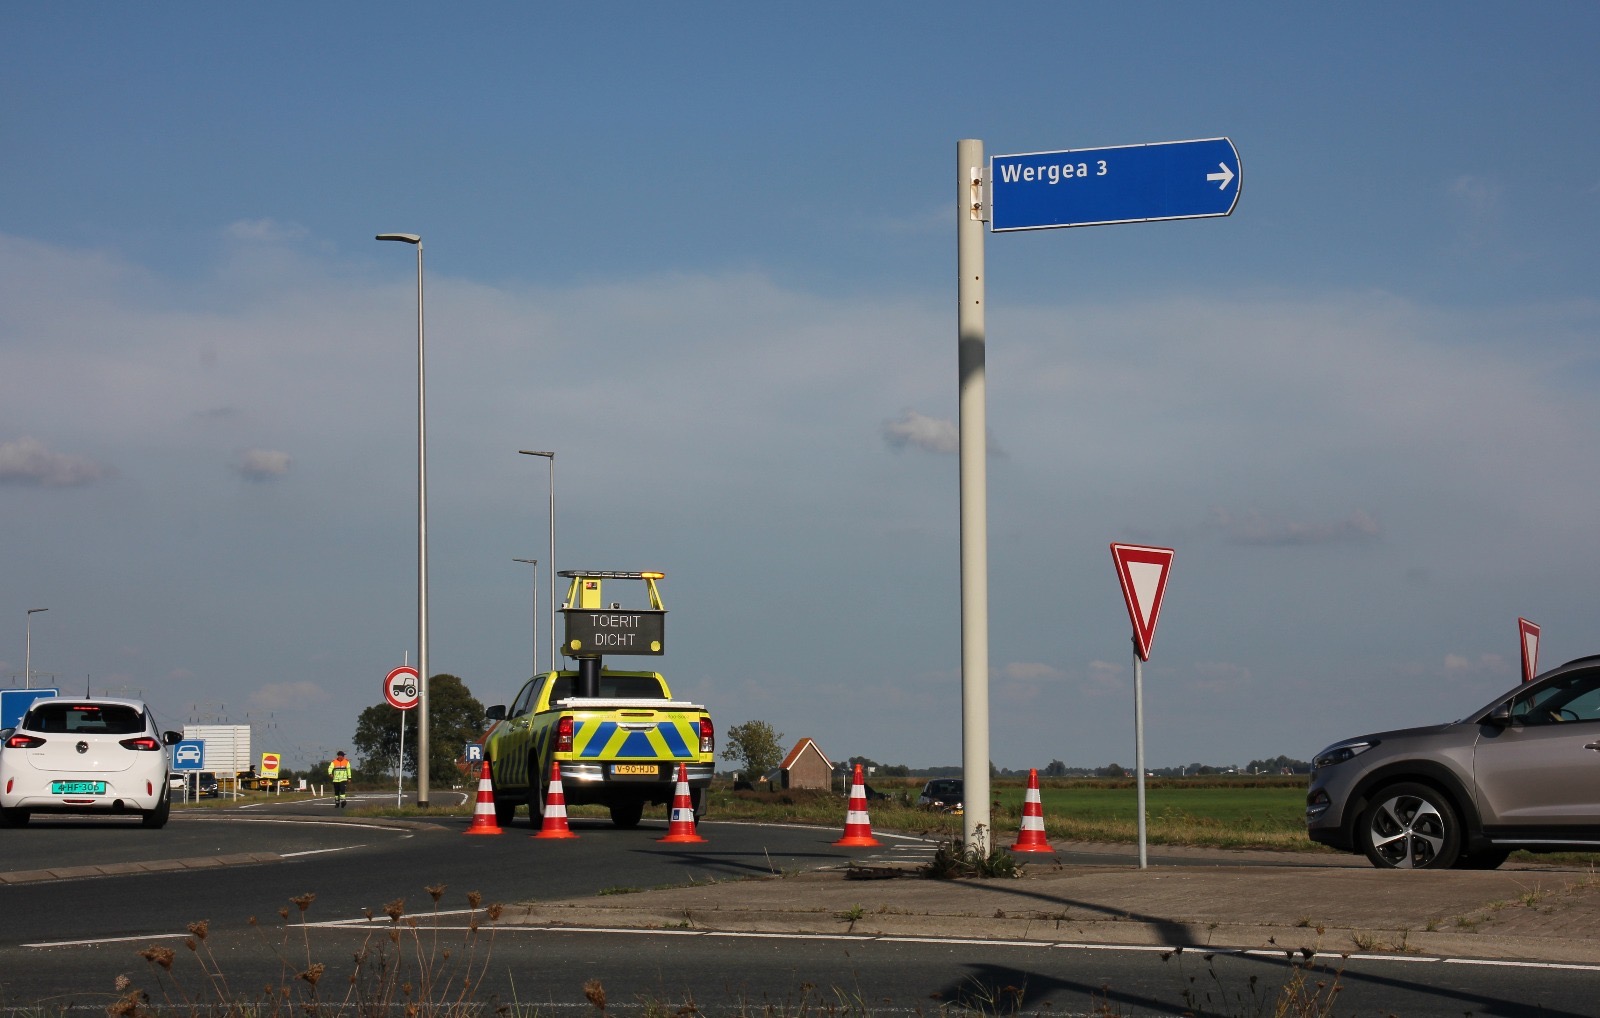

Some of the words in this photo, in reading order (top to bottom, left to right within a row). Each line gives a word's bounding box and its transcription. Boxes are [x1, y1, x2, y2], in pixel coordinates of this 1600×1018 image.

[1001, 162, 1088, 185] Wergea
[1096, 160, 1108, 176] 3
[590, 614, 641, 628] TOERIT
[595, 633, 636, 646] DICHT
[469, 747, 481, 760] R
[616, 765, 656, 774] V-90-HJD
